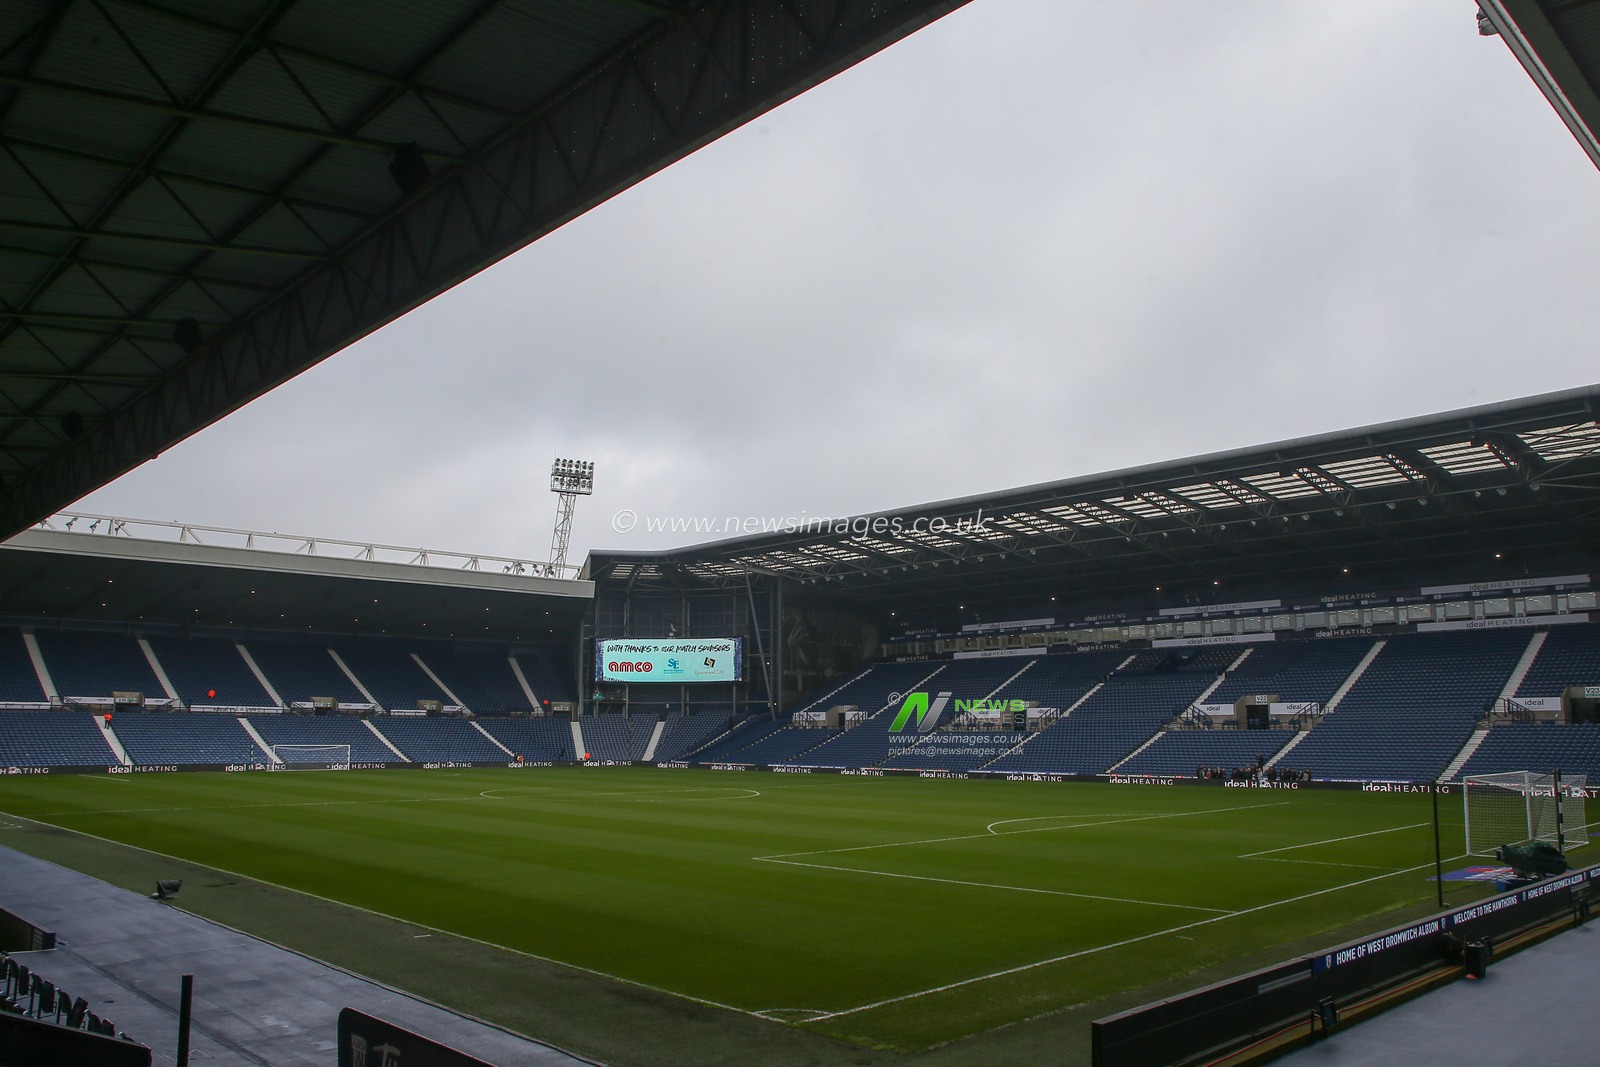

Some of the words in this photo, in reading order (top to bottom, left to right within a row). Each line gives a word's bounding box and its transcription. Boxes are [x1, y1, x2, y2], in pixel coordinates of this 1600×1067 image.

[1469, 582, 1489, 591] ideal
[1490, 580, 1536, 588] HEATING
[1320, 595, 1338, 603] ideal
[1339, 592, 1377, 600] HEATING
[1210, 603, 1242, 611] HEATING
[1466, 620, 1486, 628] ideal
[1487, 617, 1533, 627] HEATING
[1315, 630, 1333, 638] ideal
[1333, 628, 1372, 636] HEATING
[1203, 636, 1236, 644] HEATING
[607, 644, 623, 653] WITH
[624, 644, 652, 653] THANKS
[661, 645, 675, 653] OUR
[675, 645, 697, 653] MATCH
[697, 644, 731, 653] SPONSORS
[1090, 643, 1119, 651] HEATING
[608, 661, 653, 672] amco
[225, 764, 246, 772] ideal
[508, 760, 524, 768] ideal
[108, 765, 133, 774] ideal
[134, 765, 178, 773] HEATING
[1132, 777, 1173, 786] HEATING
[1224, 779, 1249, 788] ideal
[1362, 782, 1391, 792] ideal
[1528, 888, 1538, 900] HOME
[1538, 887, 1544, 895] OF
[1544, 883, 1553, 894] WEST
[1553, 878, 1571, 891] BROMWICH
[1571, 874, 1583, 884] ALBION
[1453, 908, 1477, 925] WELCOME
[1477, 906, 1483, 917] TO
[1483, 904, 1492, 915] THE
[1492, 895, 1517, 912] HAWTHORNS
[1336, 947, 1356, 965] HOME
[1357, 944, 1367, 957] OF
[1367, 938, 1385, 954] WEST
[1385, 928, 1418, 948] BROMWICH
[1418, 920, 1439, 937] ALBION
